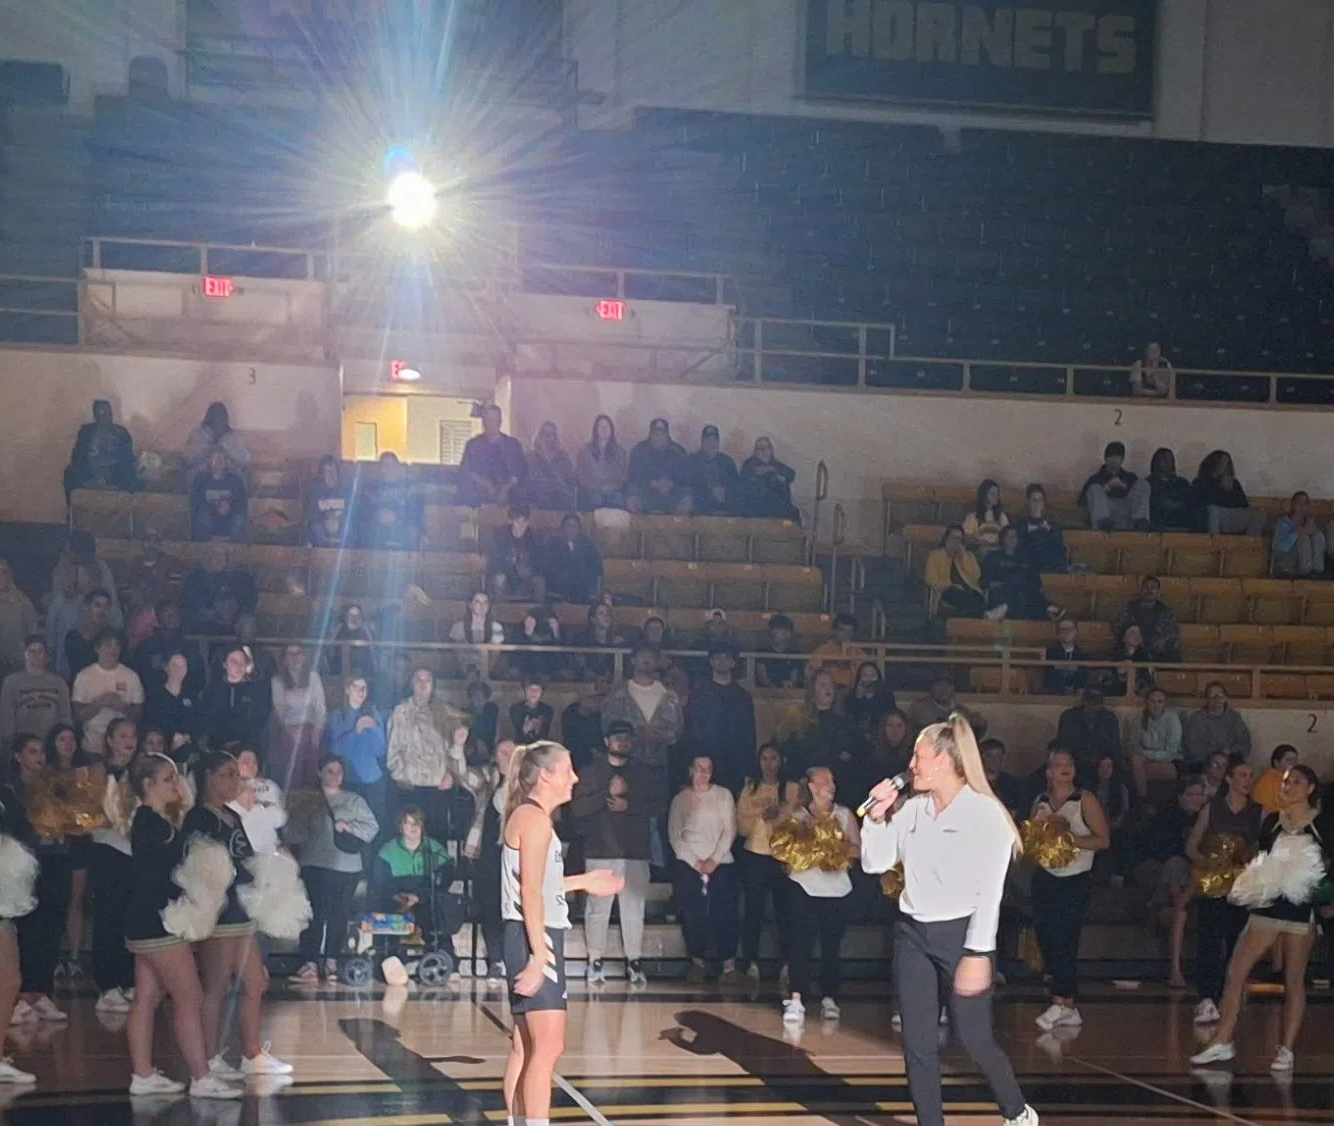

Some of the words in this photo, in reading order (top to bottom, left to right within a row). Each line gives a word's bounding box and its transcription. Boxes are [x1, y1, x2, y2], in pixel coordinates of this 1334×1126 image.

[825, 0, 1136, 74] HORNETS
[205, 276, 231, 297] EXIT
[600, 300, 624, 320] EXIT
[248, 366, 257, 386] 3
[1114, 407, 1123, 426] 2
[1307, 713, 1317, 734] 2
